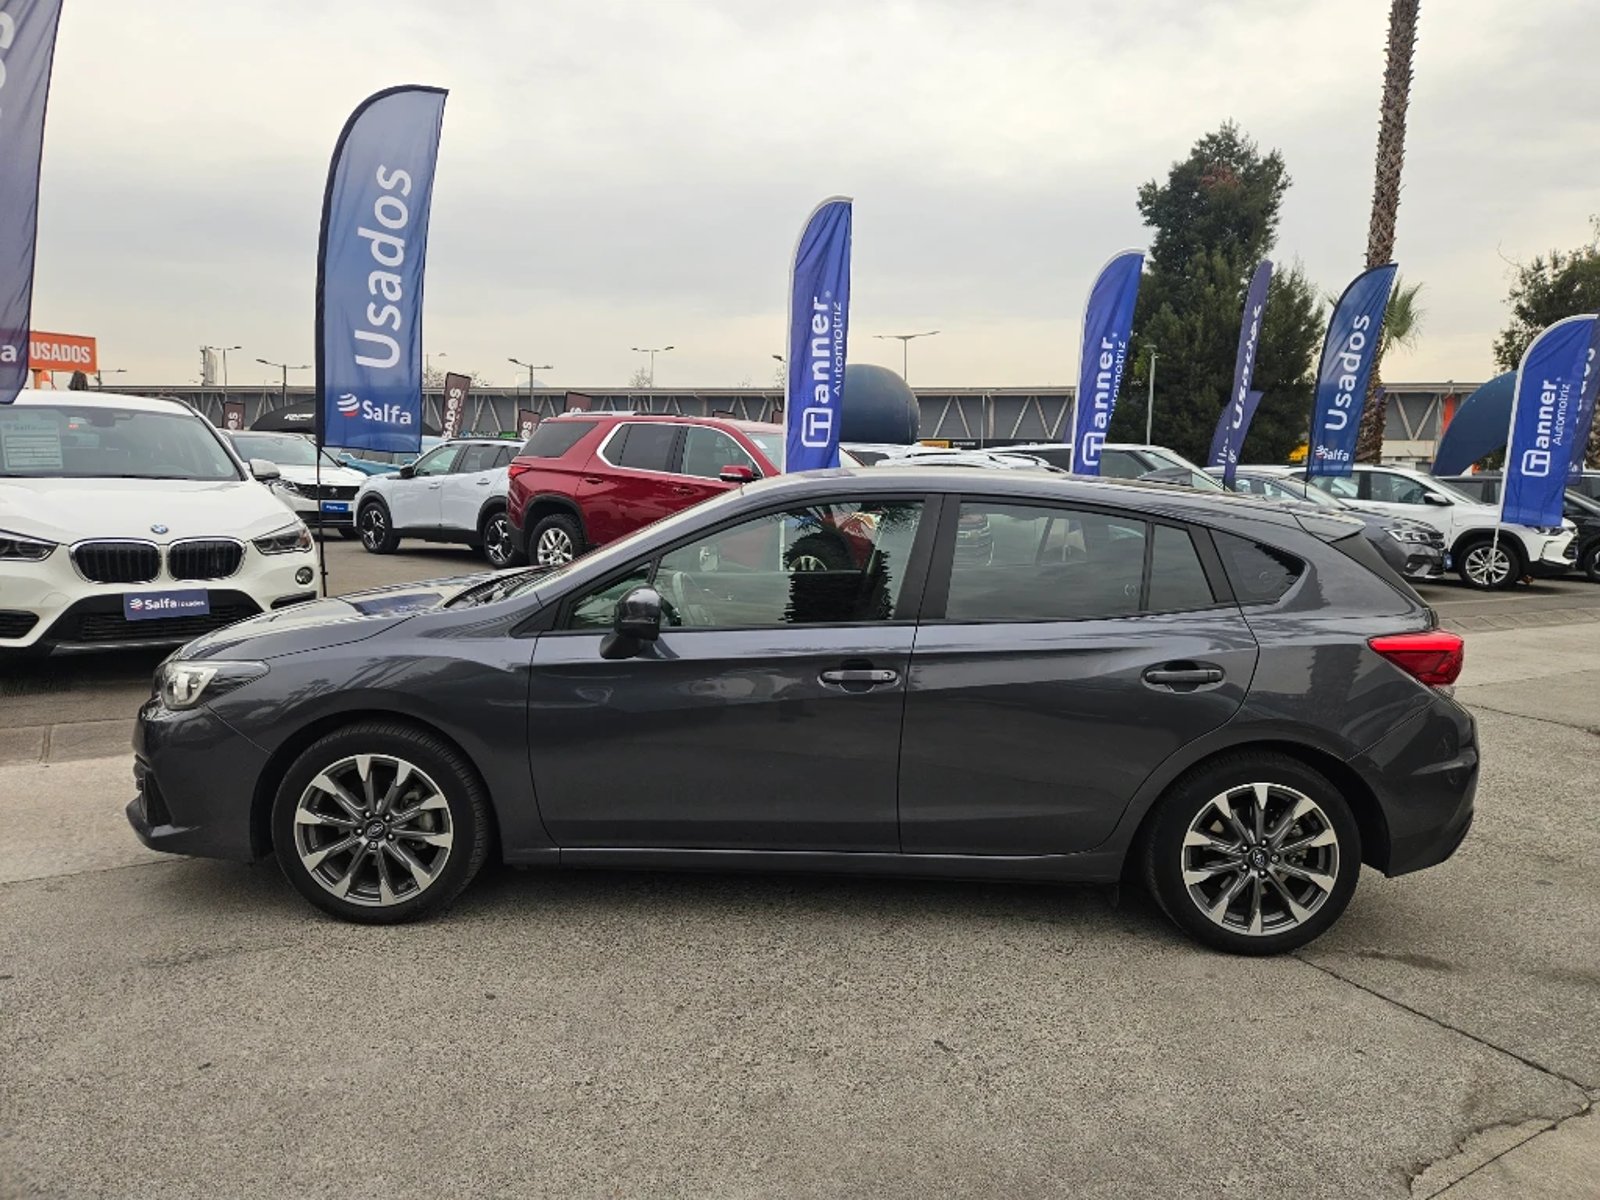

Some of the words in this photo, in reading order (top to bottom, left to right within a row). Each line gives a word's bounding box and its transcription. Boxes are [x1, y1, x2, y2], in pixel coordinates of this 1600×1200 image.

[354, 164, 412, 369] Usados
[30, 341, 91, 363] USADOS
[802, 296, 832, 448] Tanner
[833, 301, 843, 396] Automotriz
[1325, 314, 1370, 431] Usados
[362, 400, 412, 425] Salfa
[1521, 379, 1557, 477] Tanner
[1552, 383, 1571, 446] Automotriz
[144, 598, 177, 610] Salfa
